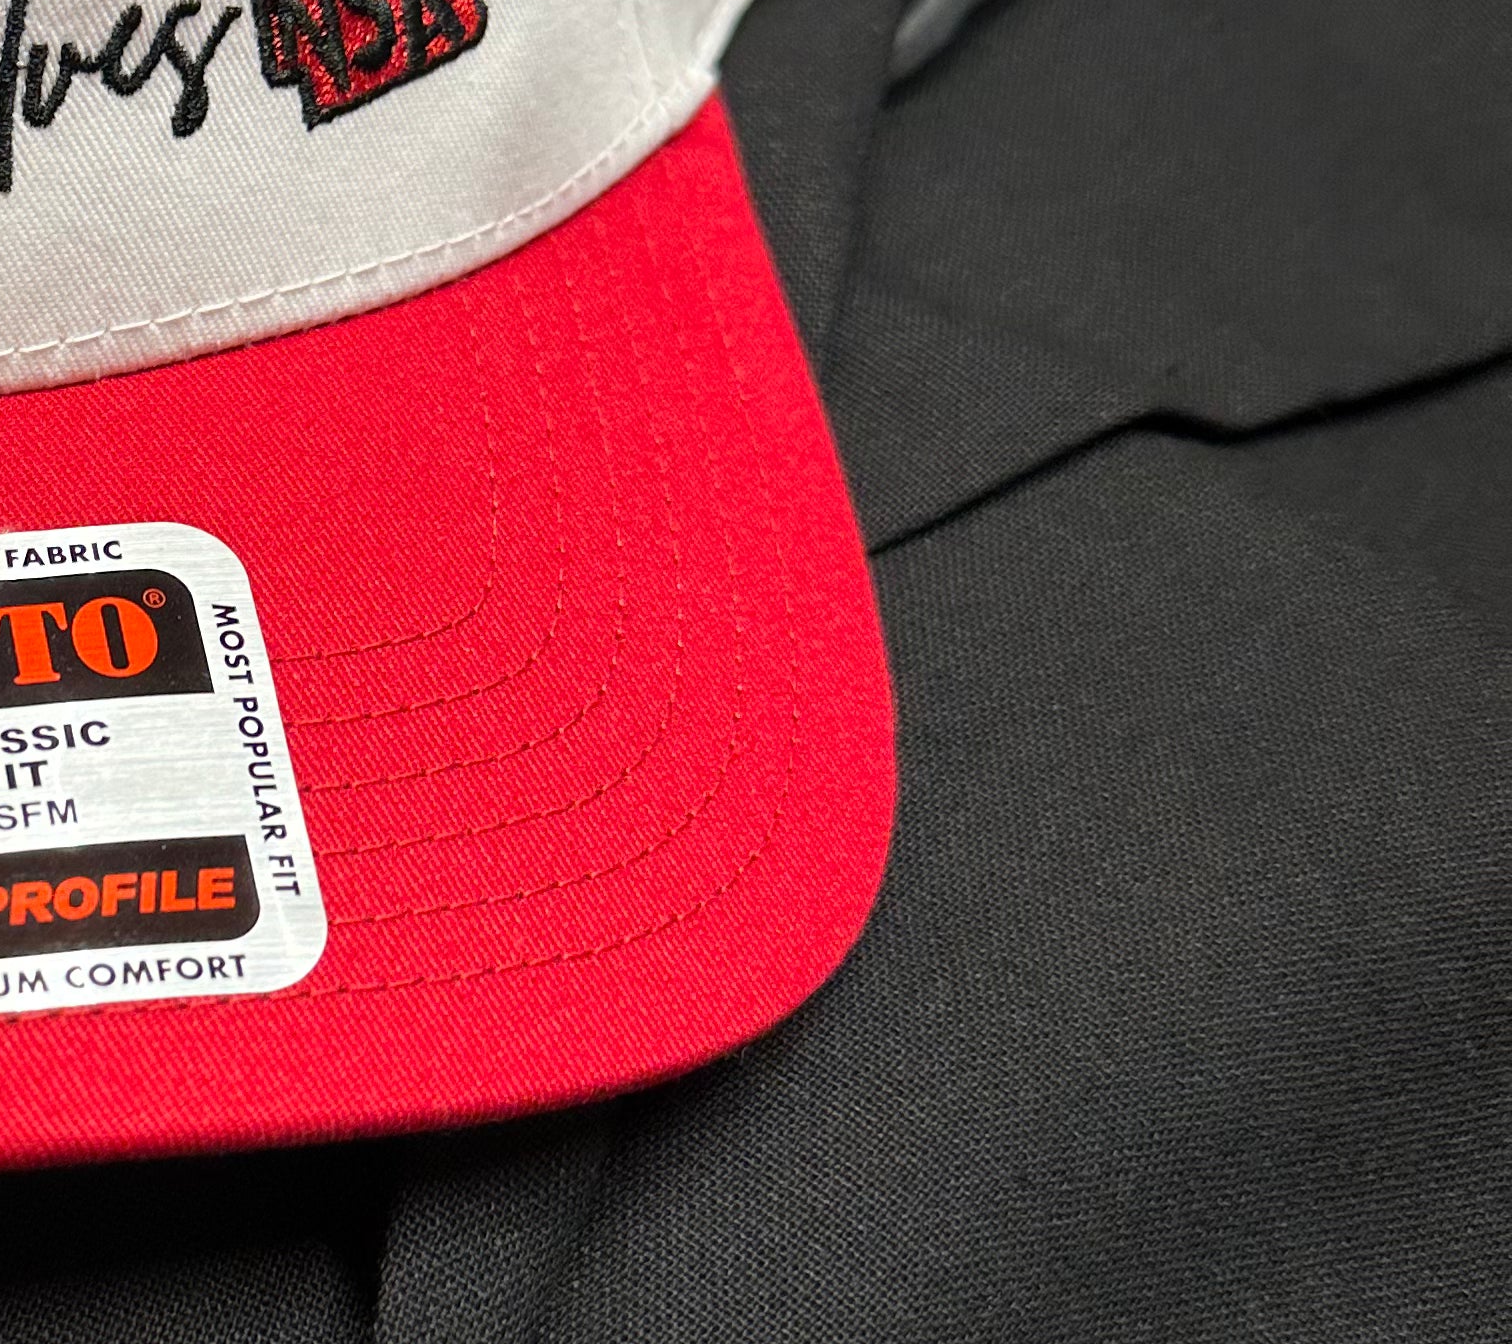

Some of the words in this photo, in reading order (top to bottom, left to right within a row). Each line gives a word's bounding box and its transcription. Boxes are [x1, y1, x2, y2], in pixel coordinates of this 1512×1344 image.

[6, 539, 123, 571] FABRIC
[212, 603, 256, 684] MOST
[233, 696, 287, 841] POPULAR
[267, 855, 302, 897] FIT
[65, 953, 248, 989] COMFORT
